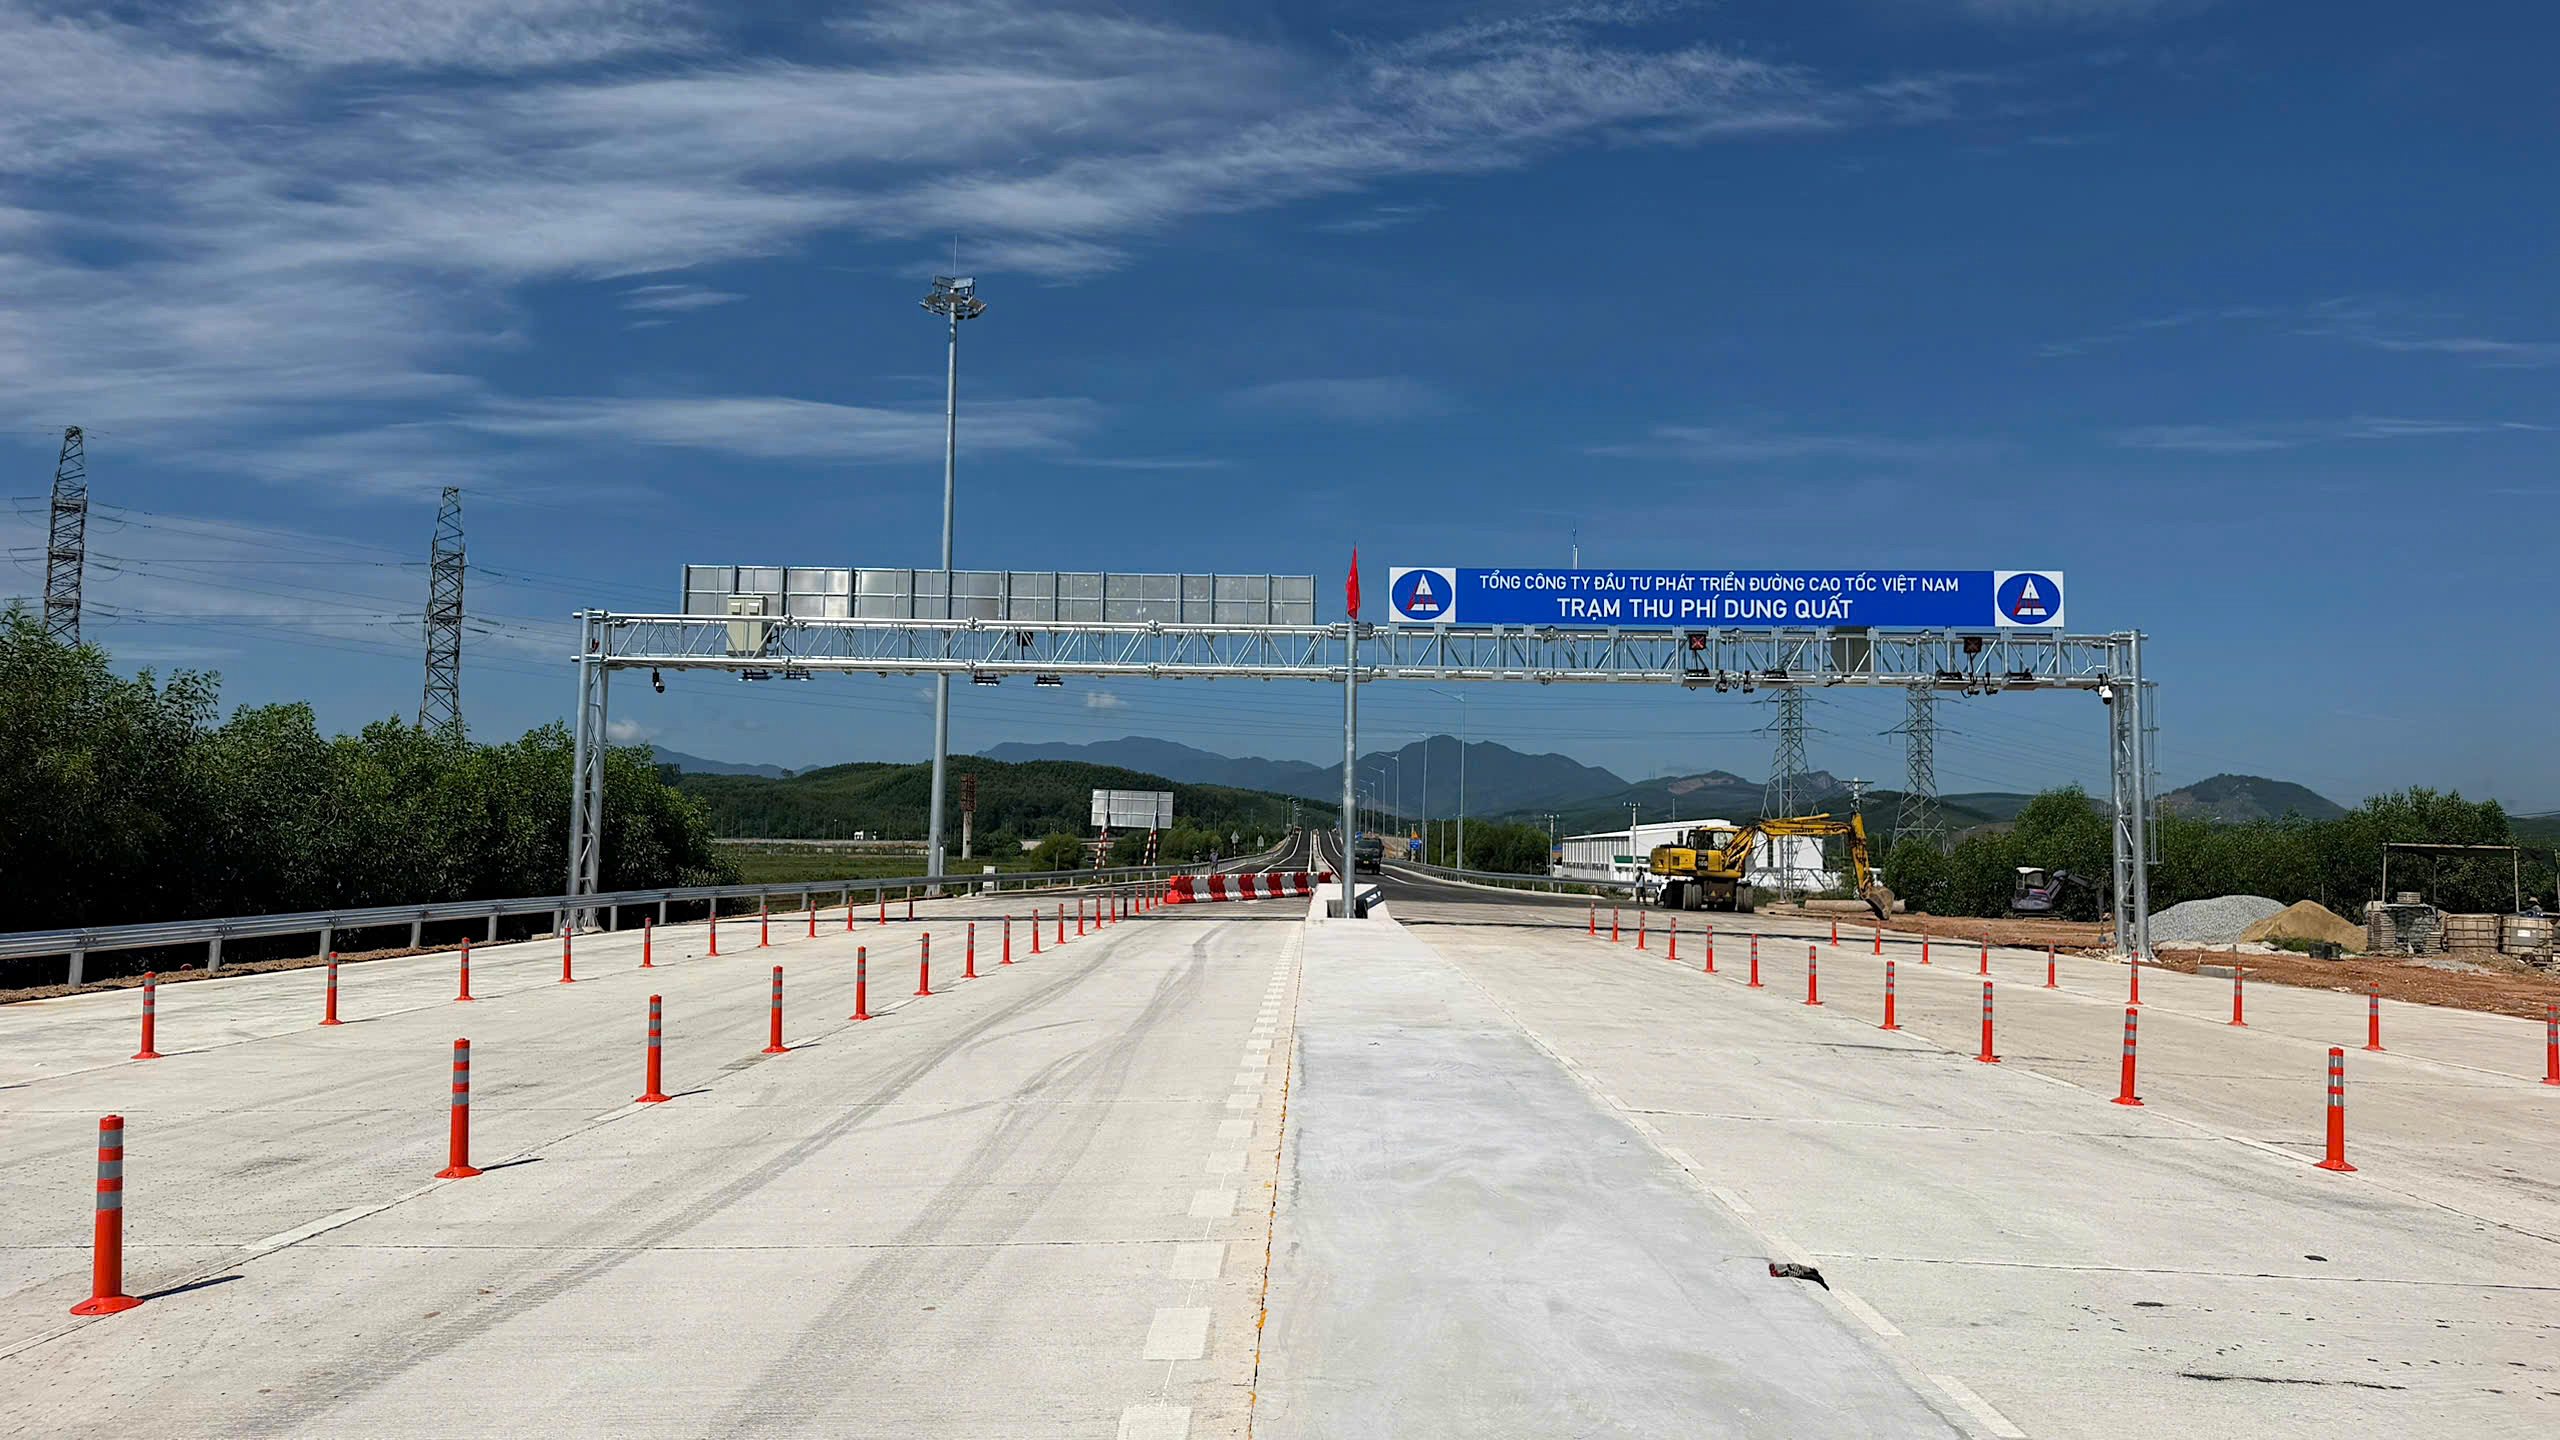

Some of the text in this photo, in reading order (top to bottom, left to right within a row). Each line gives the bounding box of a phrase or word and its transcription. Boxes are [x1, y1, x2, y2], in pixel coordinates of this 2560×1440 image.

[1480, 569, 1959, 594] TỔNG CÔNG TY ĐẦU TƯ PHÁT TRIỂN ĐƯỜNG CAO TỐC VIỆT NAM
[1557, 592, 1853, 621] TRẠM THU PHÍ DUNG QUẤT
